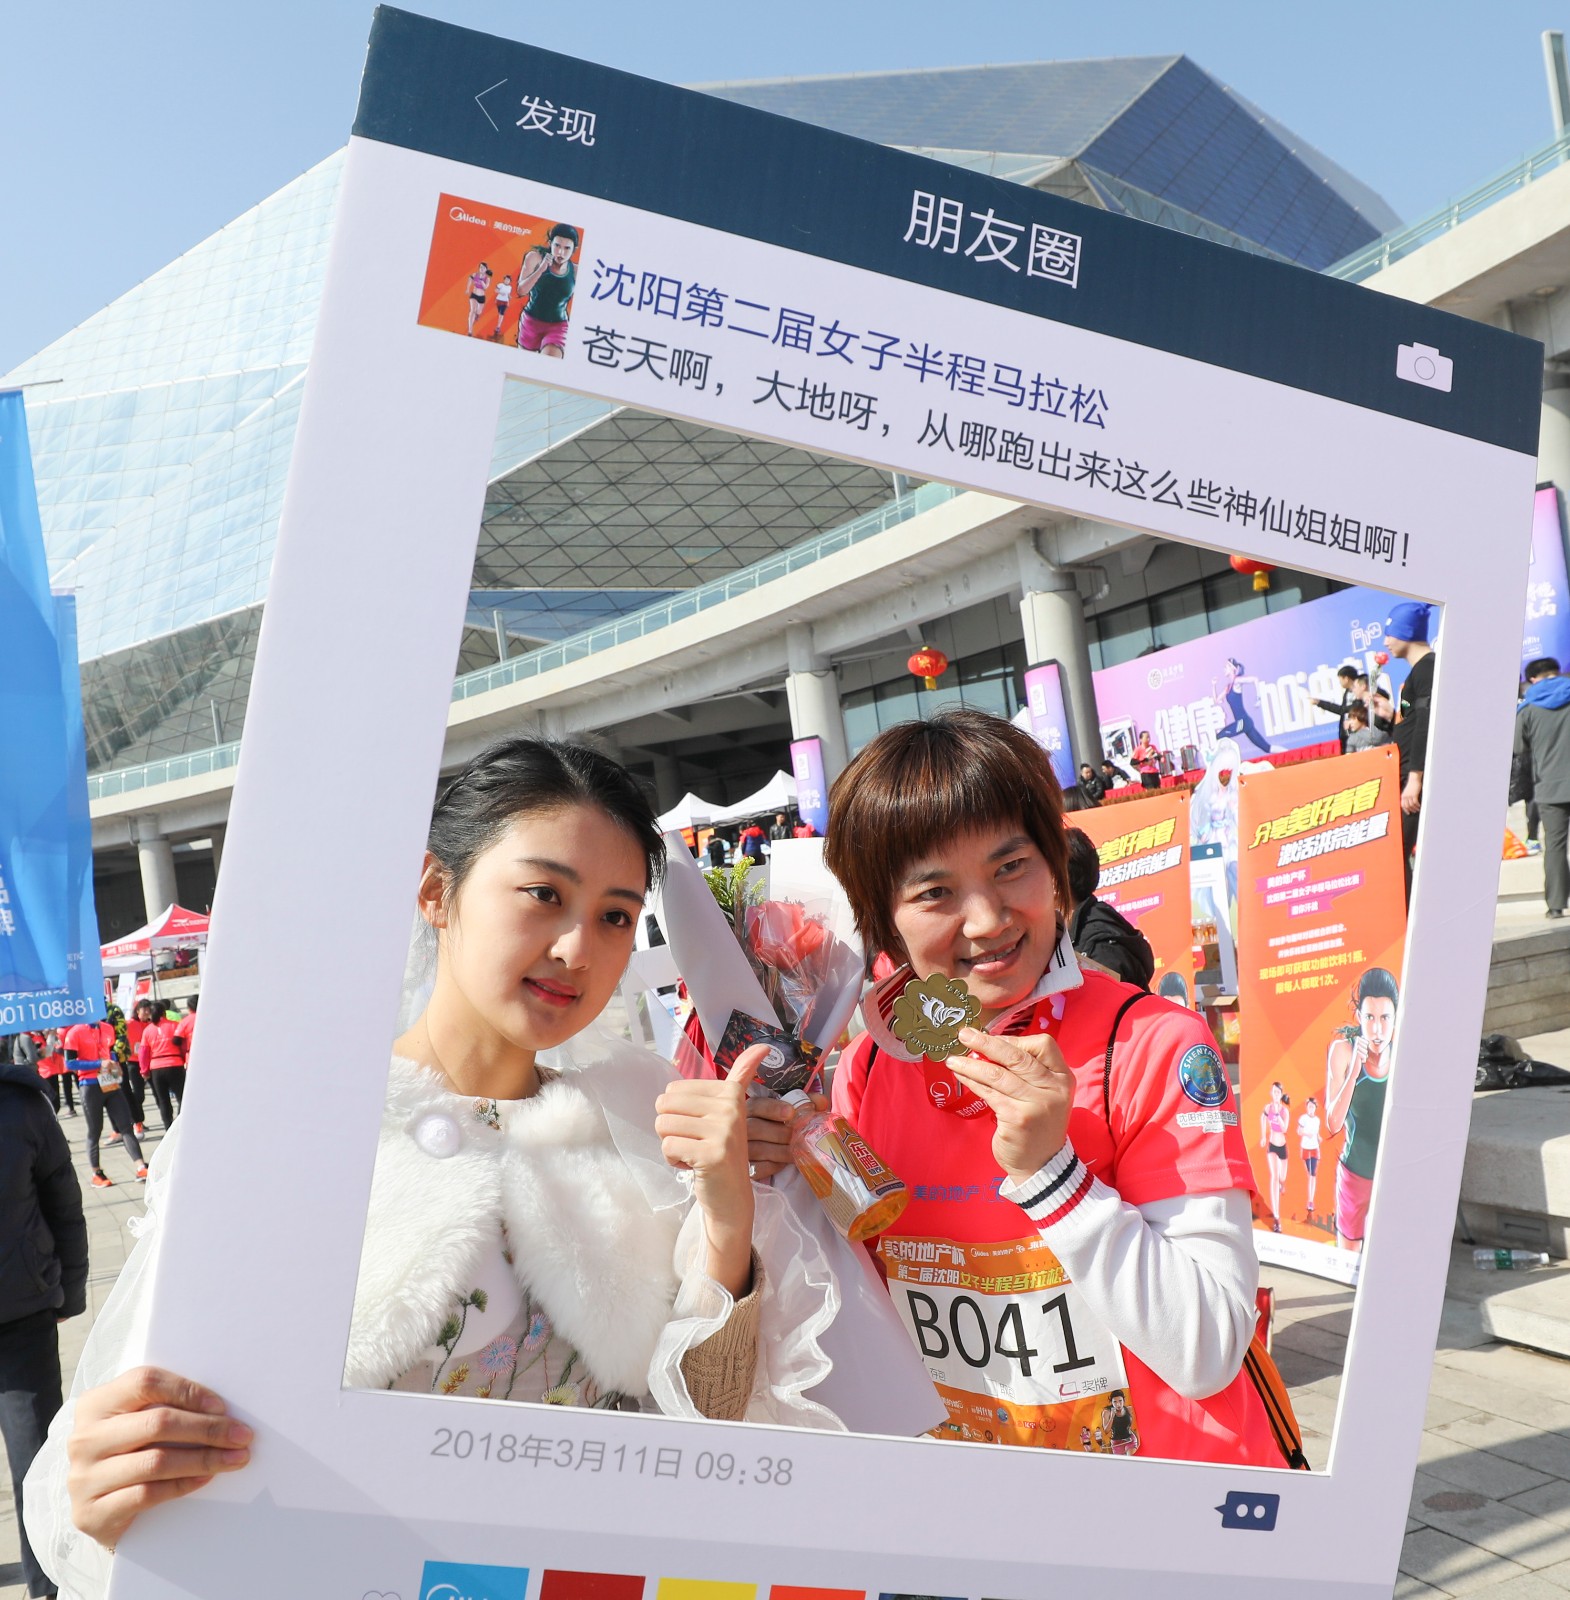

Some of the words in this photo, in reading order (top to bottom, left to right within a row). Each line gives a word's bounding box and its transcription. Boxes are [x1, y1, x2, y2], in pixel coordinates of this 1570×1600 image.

[515, 94, 597, 147] 发现
[449, 206, 487, 227] Midea
[493, 220, 532, 236] 美的地产
[904, 190, 1083, 288] 朋友圈
[590, 258, 1109, 429] 沈阳第二届女子半程马拉松
[1155, 696, 1226, 757] 健康
[1248, 777, 1382, 850] 分享美好青春
[1276, 811, 1389, 868] 激活洪荒能量
[1097, 816, 1176, 866] 美好青春
[1267, 869, 1307, 889] 美的地产杯
[0, 997, 94, 1024] 01108881
[912, 1185, 980, 1202] 美的地产
[884, 1240, 966, 1267] 美的地产杯
[907, 1289, 1095, 1377] B041
[1082, 1376, 1108, 1394] 奖牌
[430, 1427, 682, 1480] 2018年3月11日
[694, 1450, 794, 1487] 09:38
